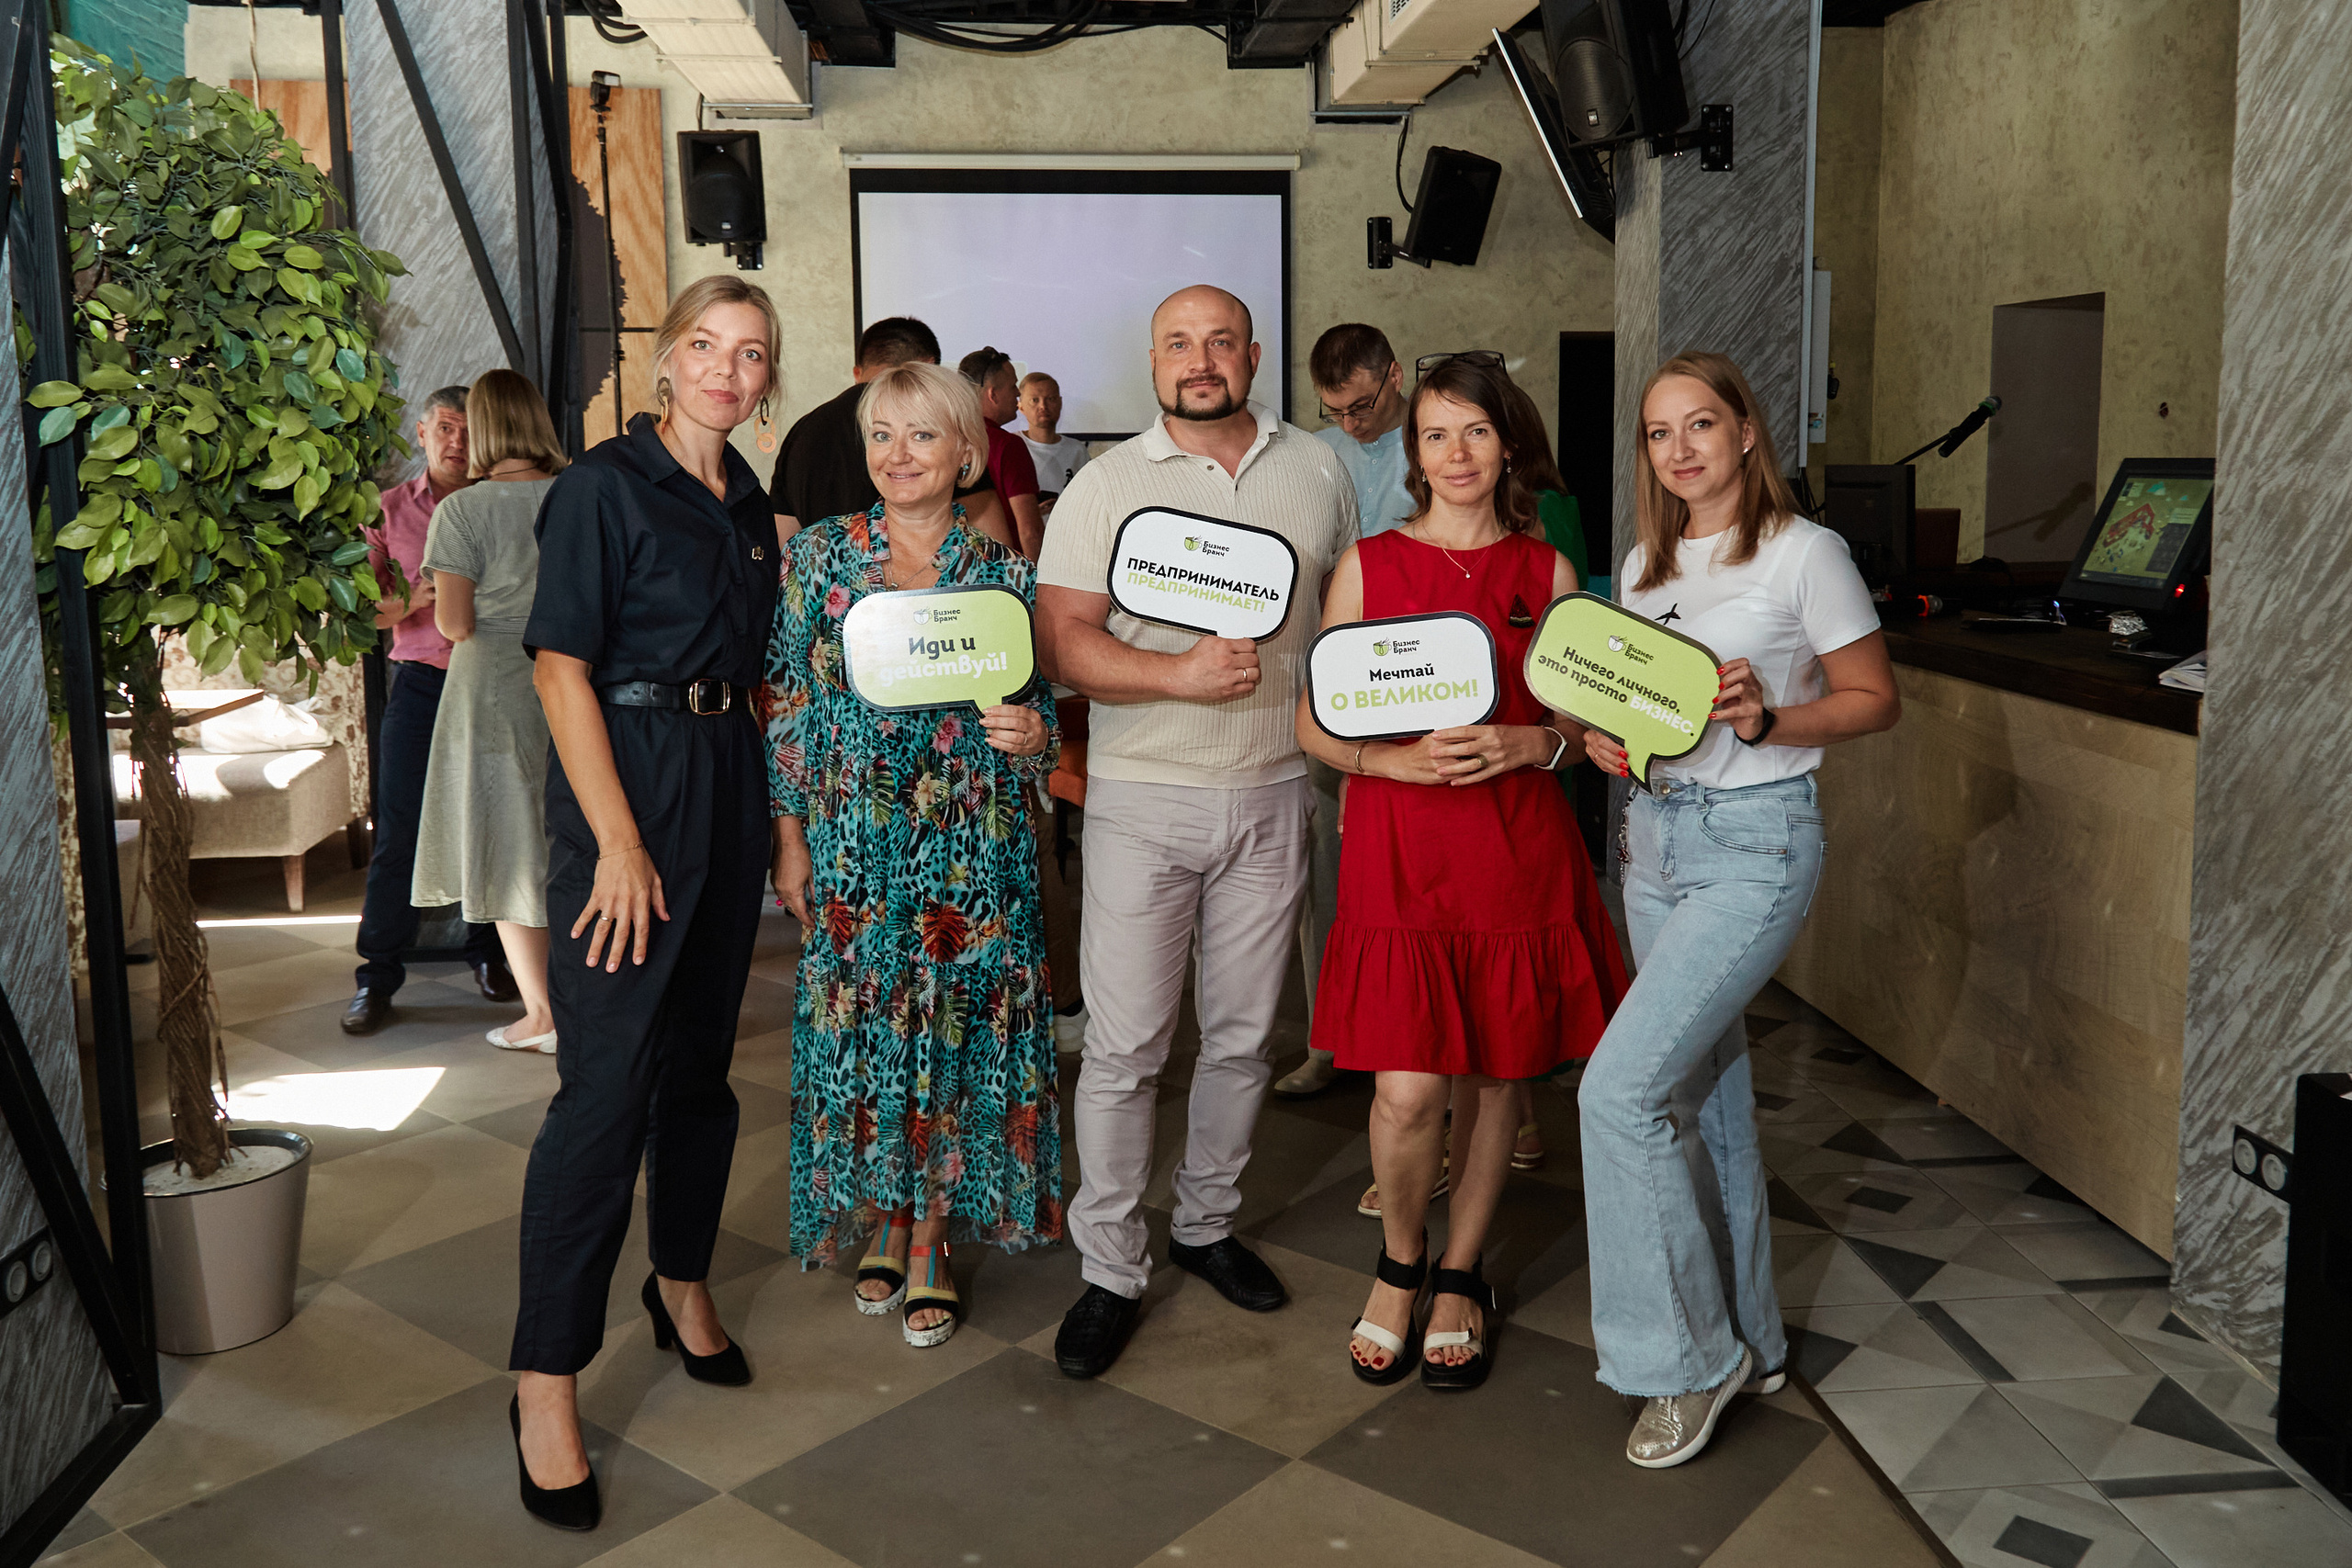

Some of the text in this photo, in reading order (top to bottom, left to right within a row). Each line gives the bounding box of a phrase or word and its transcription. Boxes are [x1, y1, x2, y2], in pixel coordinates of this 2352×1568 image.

[1202, 547, 1226, 558] Бранч
[1203, 540, 1230, 553] Бизнес
[1126, 557, 1280, 602] ПРЕДПРИНИМАТЕЛЬ
[1126, 571, 1266, 613] ПРЕДПРИНИМАЕТ!
[933, 608, 961, 617] Бизнес
[933, 615, 958, 624] Бранч
[908, 636, 977, 660] Иди и
[1392, 638, 1420, 649] Бизнес
[1393, 646, 1418, 655] Бранч
[1626, 643, 1655, 661] Бизнес
[1624, 649, 1648, 666] Бранч
[878, 651, 1008, 688] действуй!
[1369, 662, 1435, 682] Мечтай
[1562, 646, 1681, 715] Ничего личного,
[1330, 679, 1478, 711] О ВЕЛИКОМ!
[1537, 654, 1695, 737] это просто БИЗНЕС.
